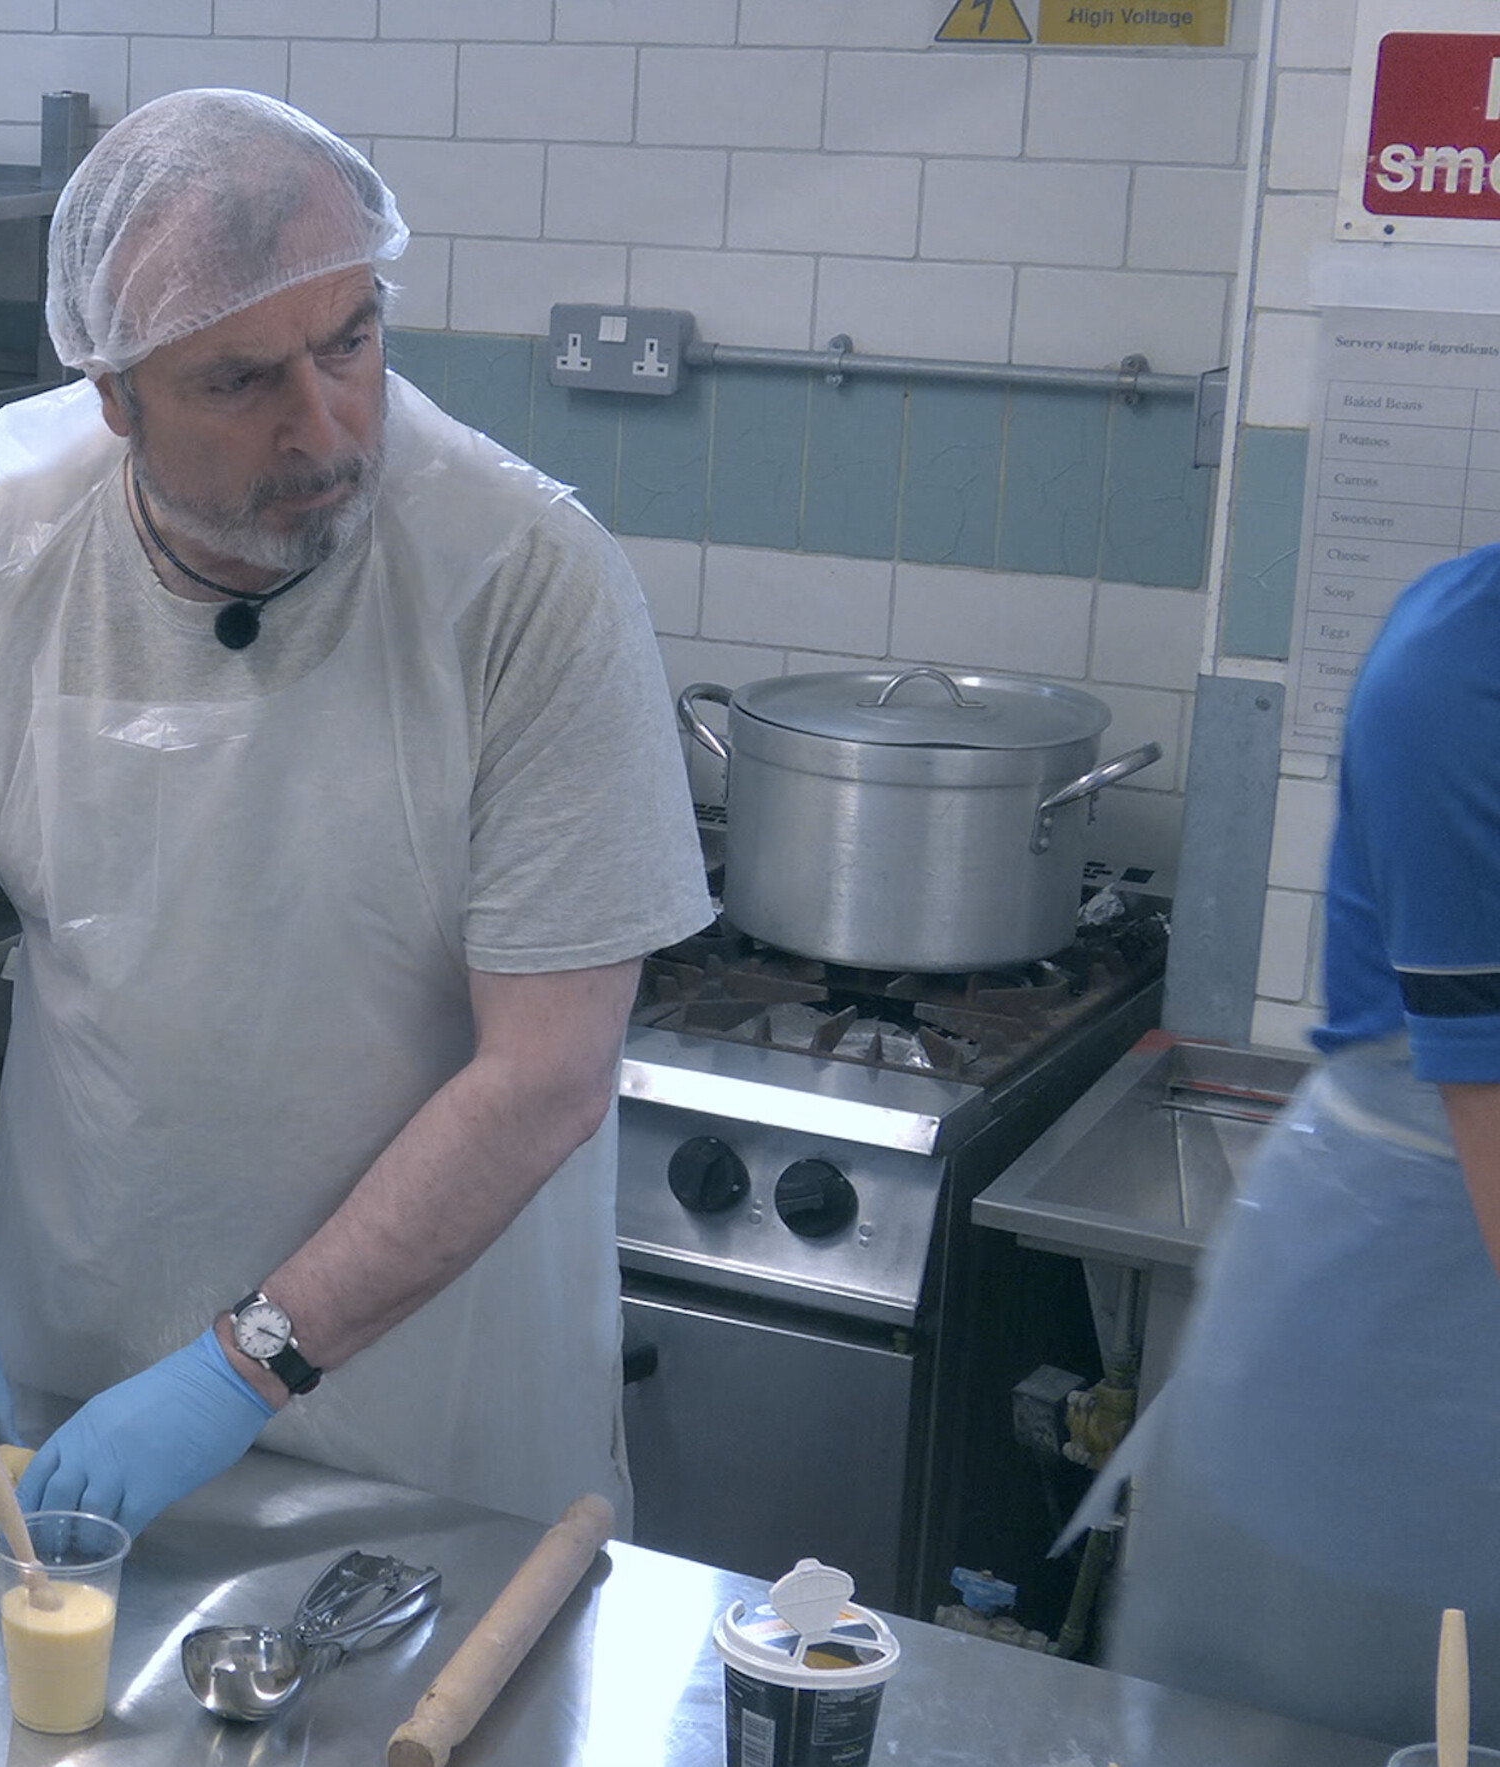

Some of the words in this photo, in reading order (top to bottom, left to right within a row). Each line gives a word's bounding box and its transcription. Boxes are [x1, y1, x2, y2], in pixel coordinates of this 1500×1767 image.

[1070, 8, 1115, 28] High
[1121, 8, 1193, 28] Voltage
[1335, 335, 1382, 352] Servery
[1387, 339, 1425, 353] staple
[1429, 341, 1499, 356] ingredients
[1343, 395, 1381, 408] Baked
[1385, 398, 1423, 411] Beans
[1338, 432, 1390, 447] Potatoes
[1334, 473, 1379, 487] Carrots
[1331, 511, 1394, 527] Sweetcorn
[1327, 548, 1370, 562] Cheese
[1324, 585, 1355, 600] Soup
[1320, 625, 1350, 640] Eggs
